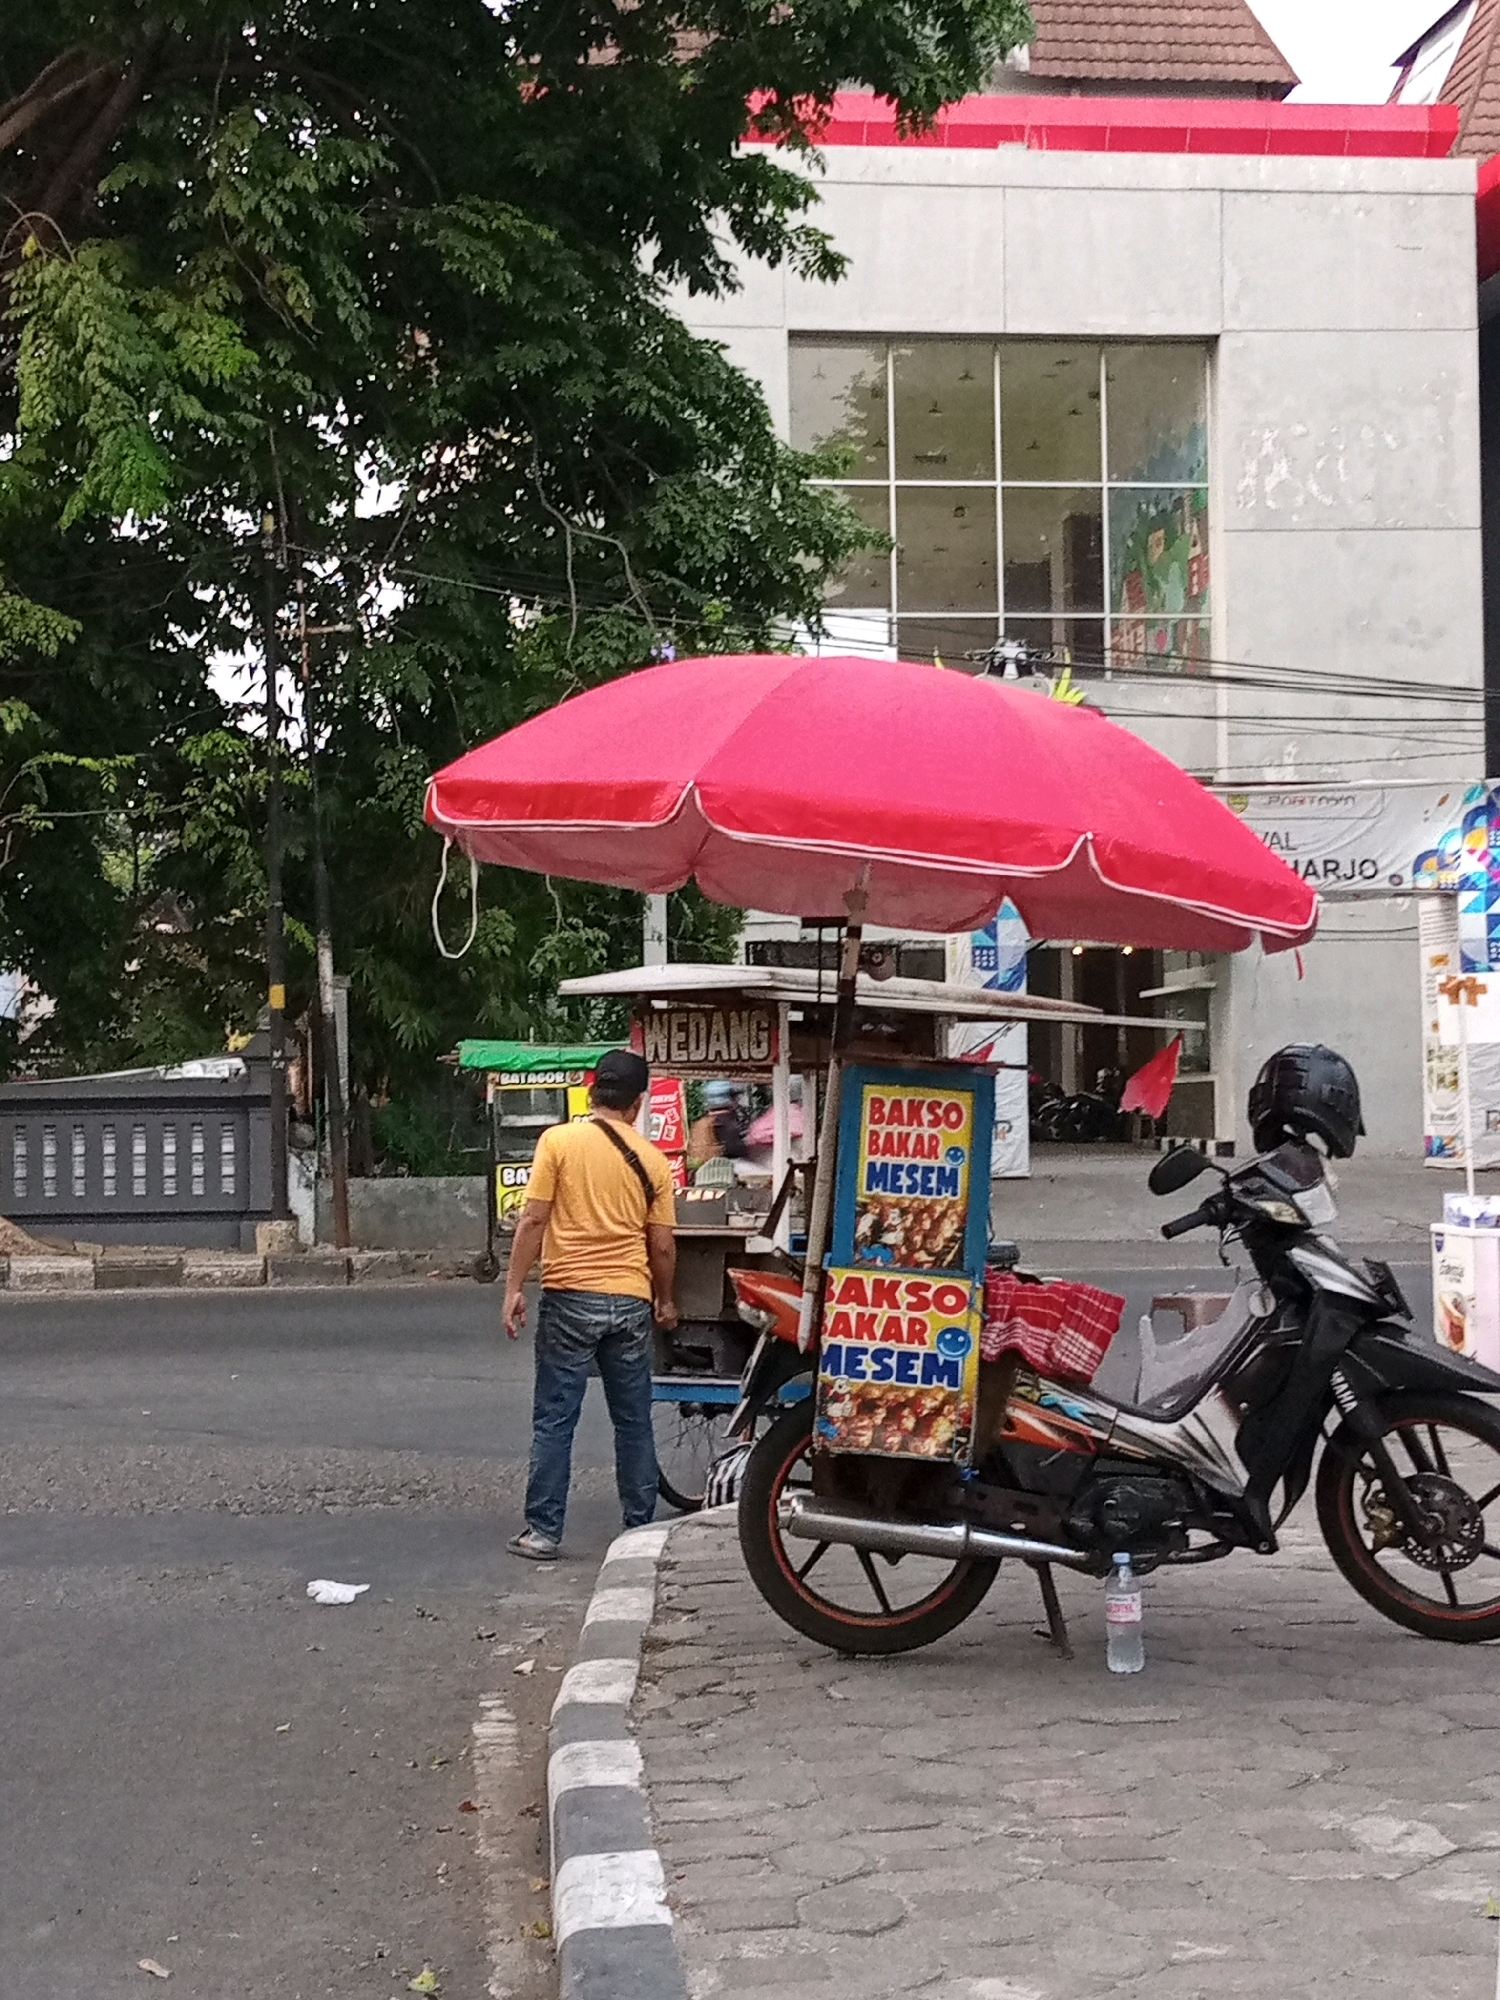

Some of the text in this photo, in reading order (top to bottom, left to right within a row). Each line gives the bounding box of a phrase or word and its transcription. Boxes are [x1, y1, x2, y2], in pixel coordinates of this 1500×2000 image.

[643, 1009, 770, 1063] WEDANG
[500, 1071, 566, 1085] BATAGOR
[868, 1096, 965, 1131] BAKSO
[867, 1129, 942, 1161] BAKAR
[502, 1167, 532, 1186] BA
[865, 1161, 960, 1197] MESEM
[822, 1311, 930, 1346] AKAR
[821, 1343, 961, 1389] MESEM
